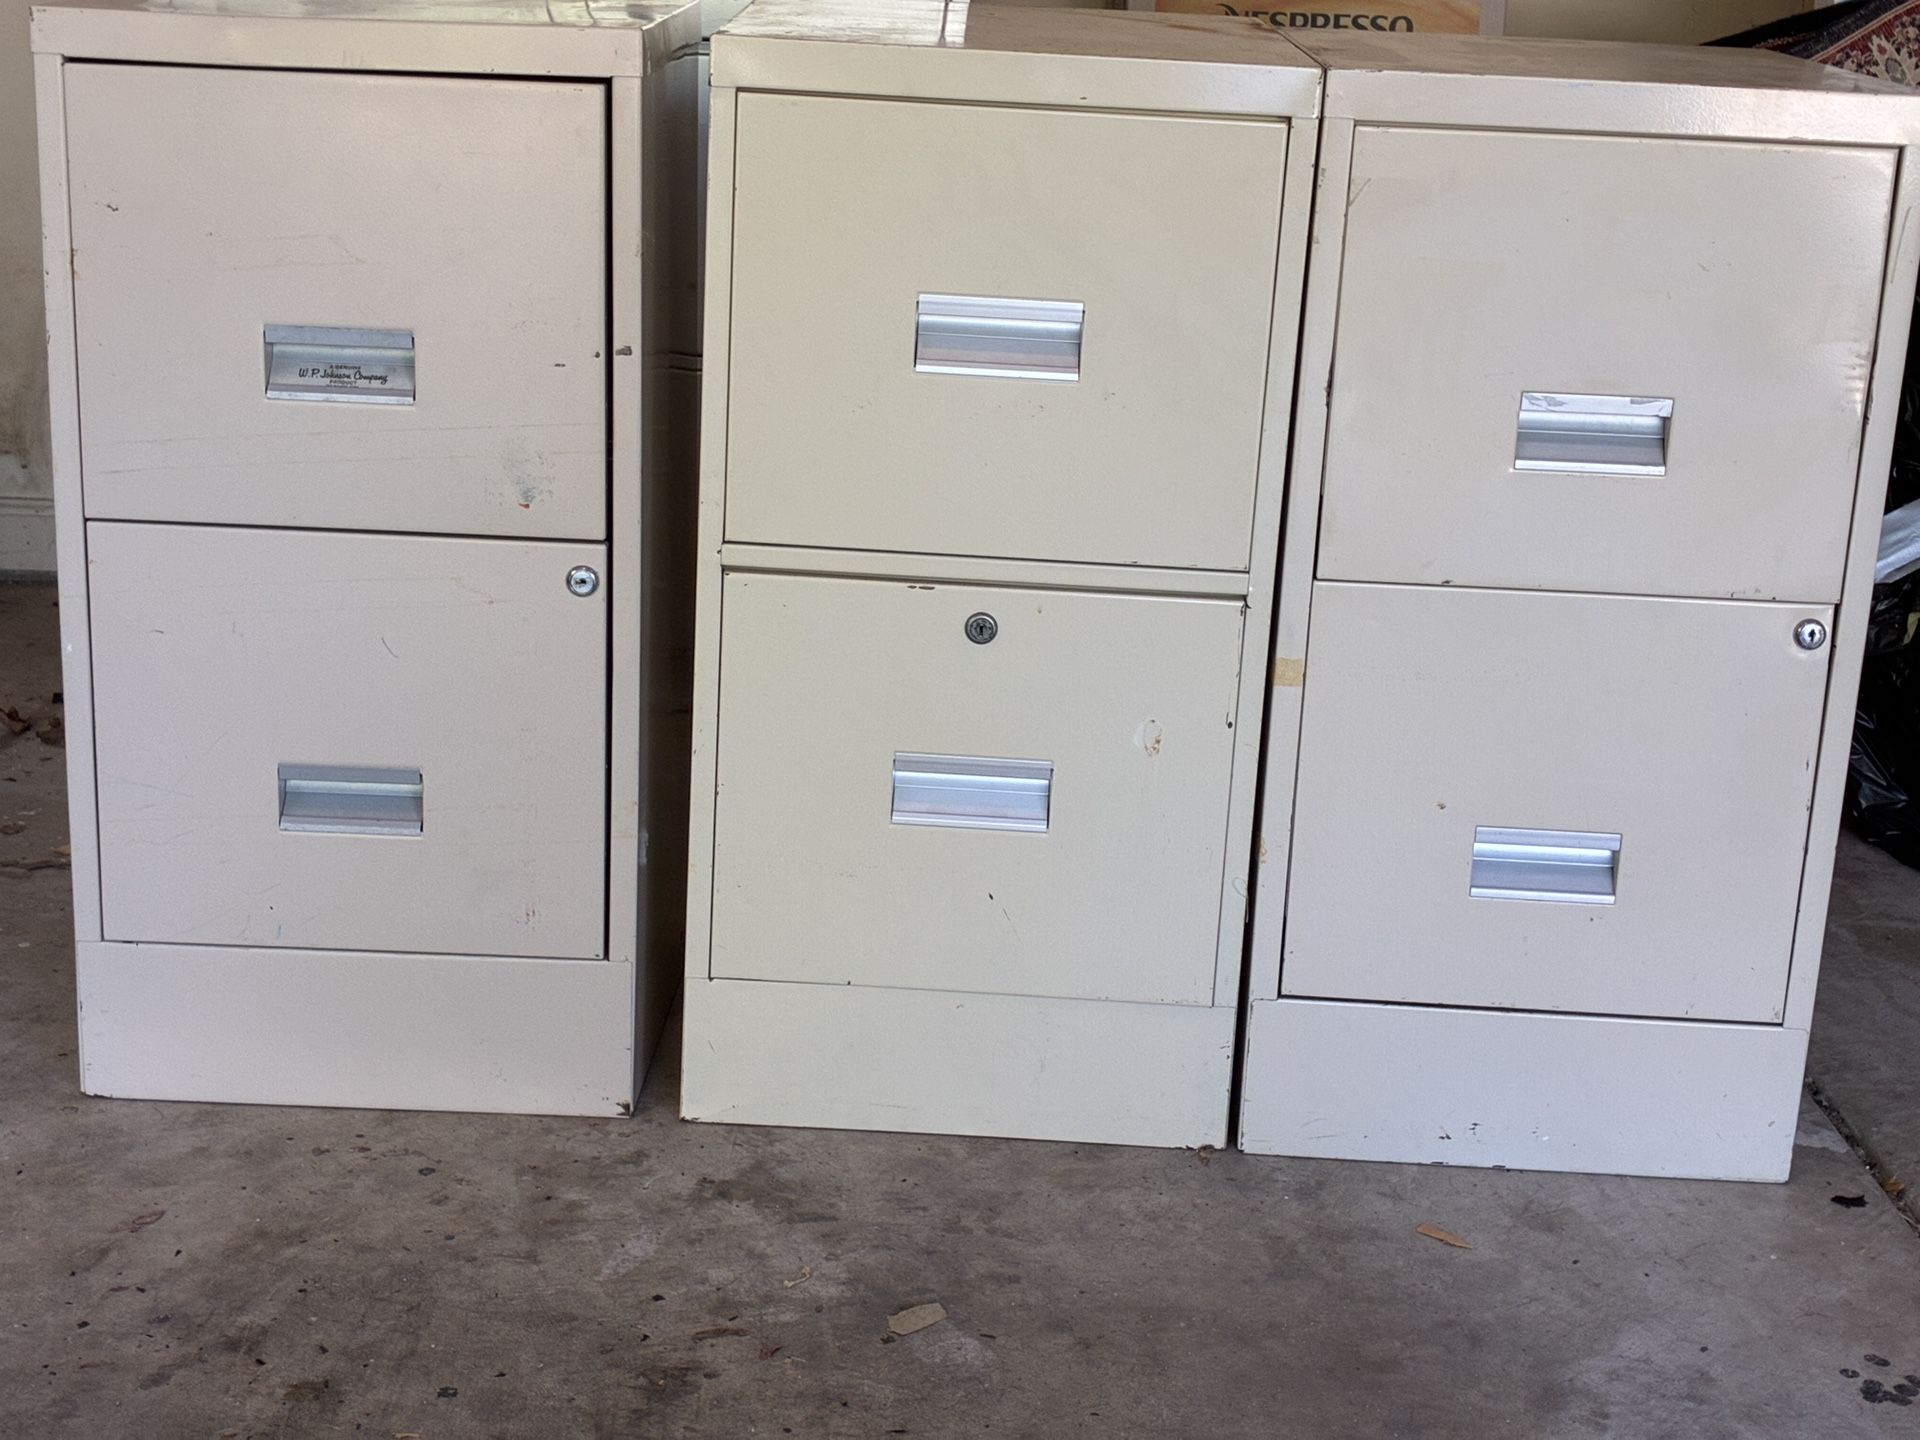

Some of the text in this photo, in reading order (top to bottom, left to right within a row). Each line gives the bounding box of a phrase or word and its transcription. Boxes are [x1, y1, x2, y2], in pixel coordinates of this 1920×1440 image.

[1216, 3, 1414, 32] SPRESSO
[320, 369, 352, 379] Johnson
[354, 369, 388, 385] Company
